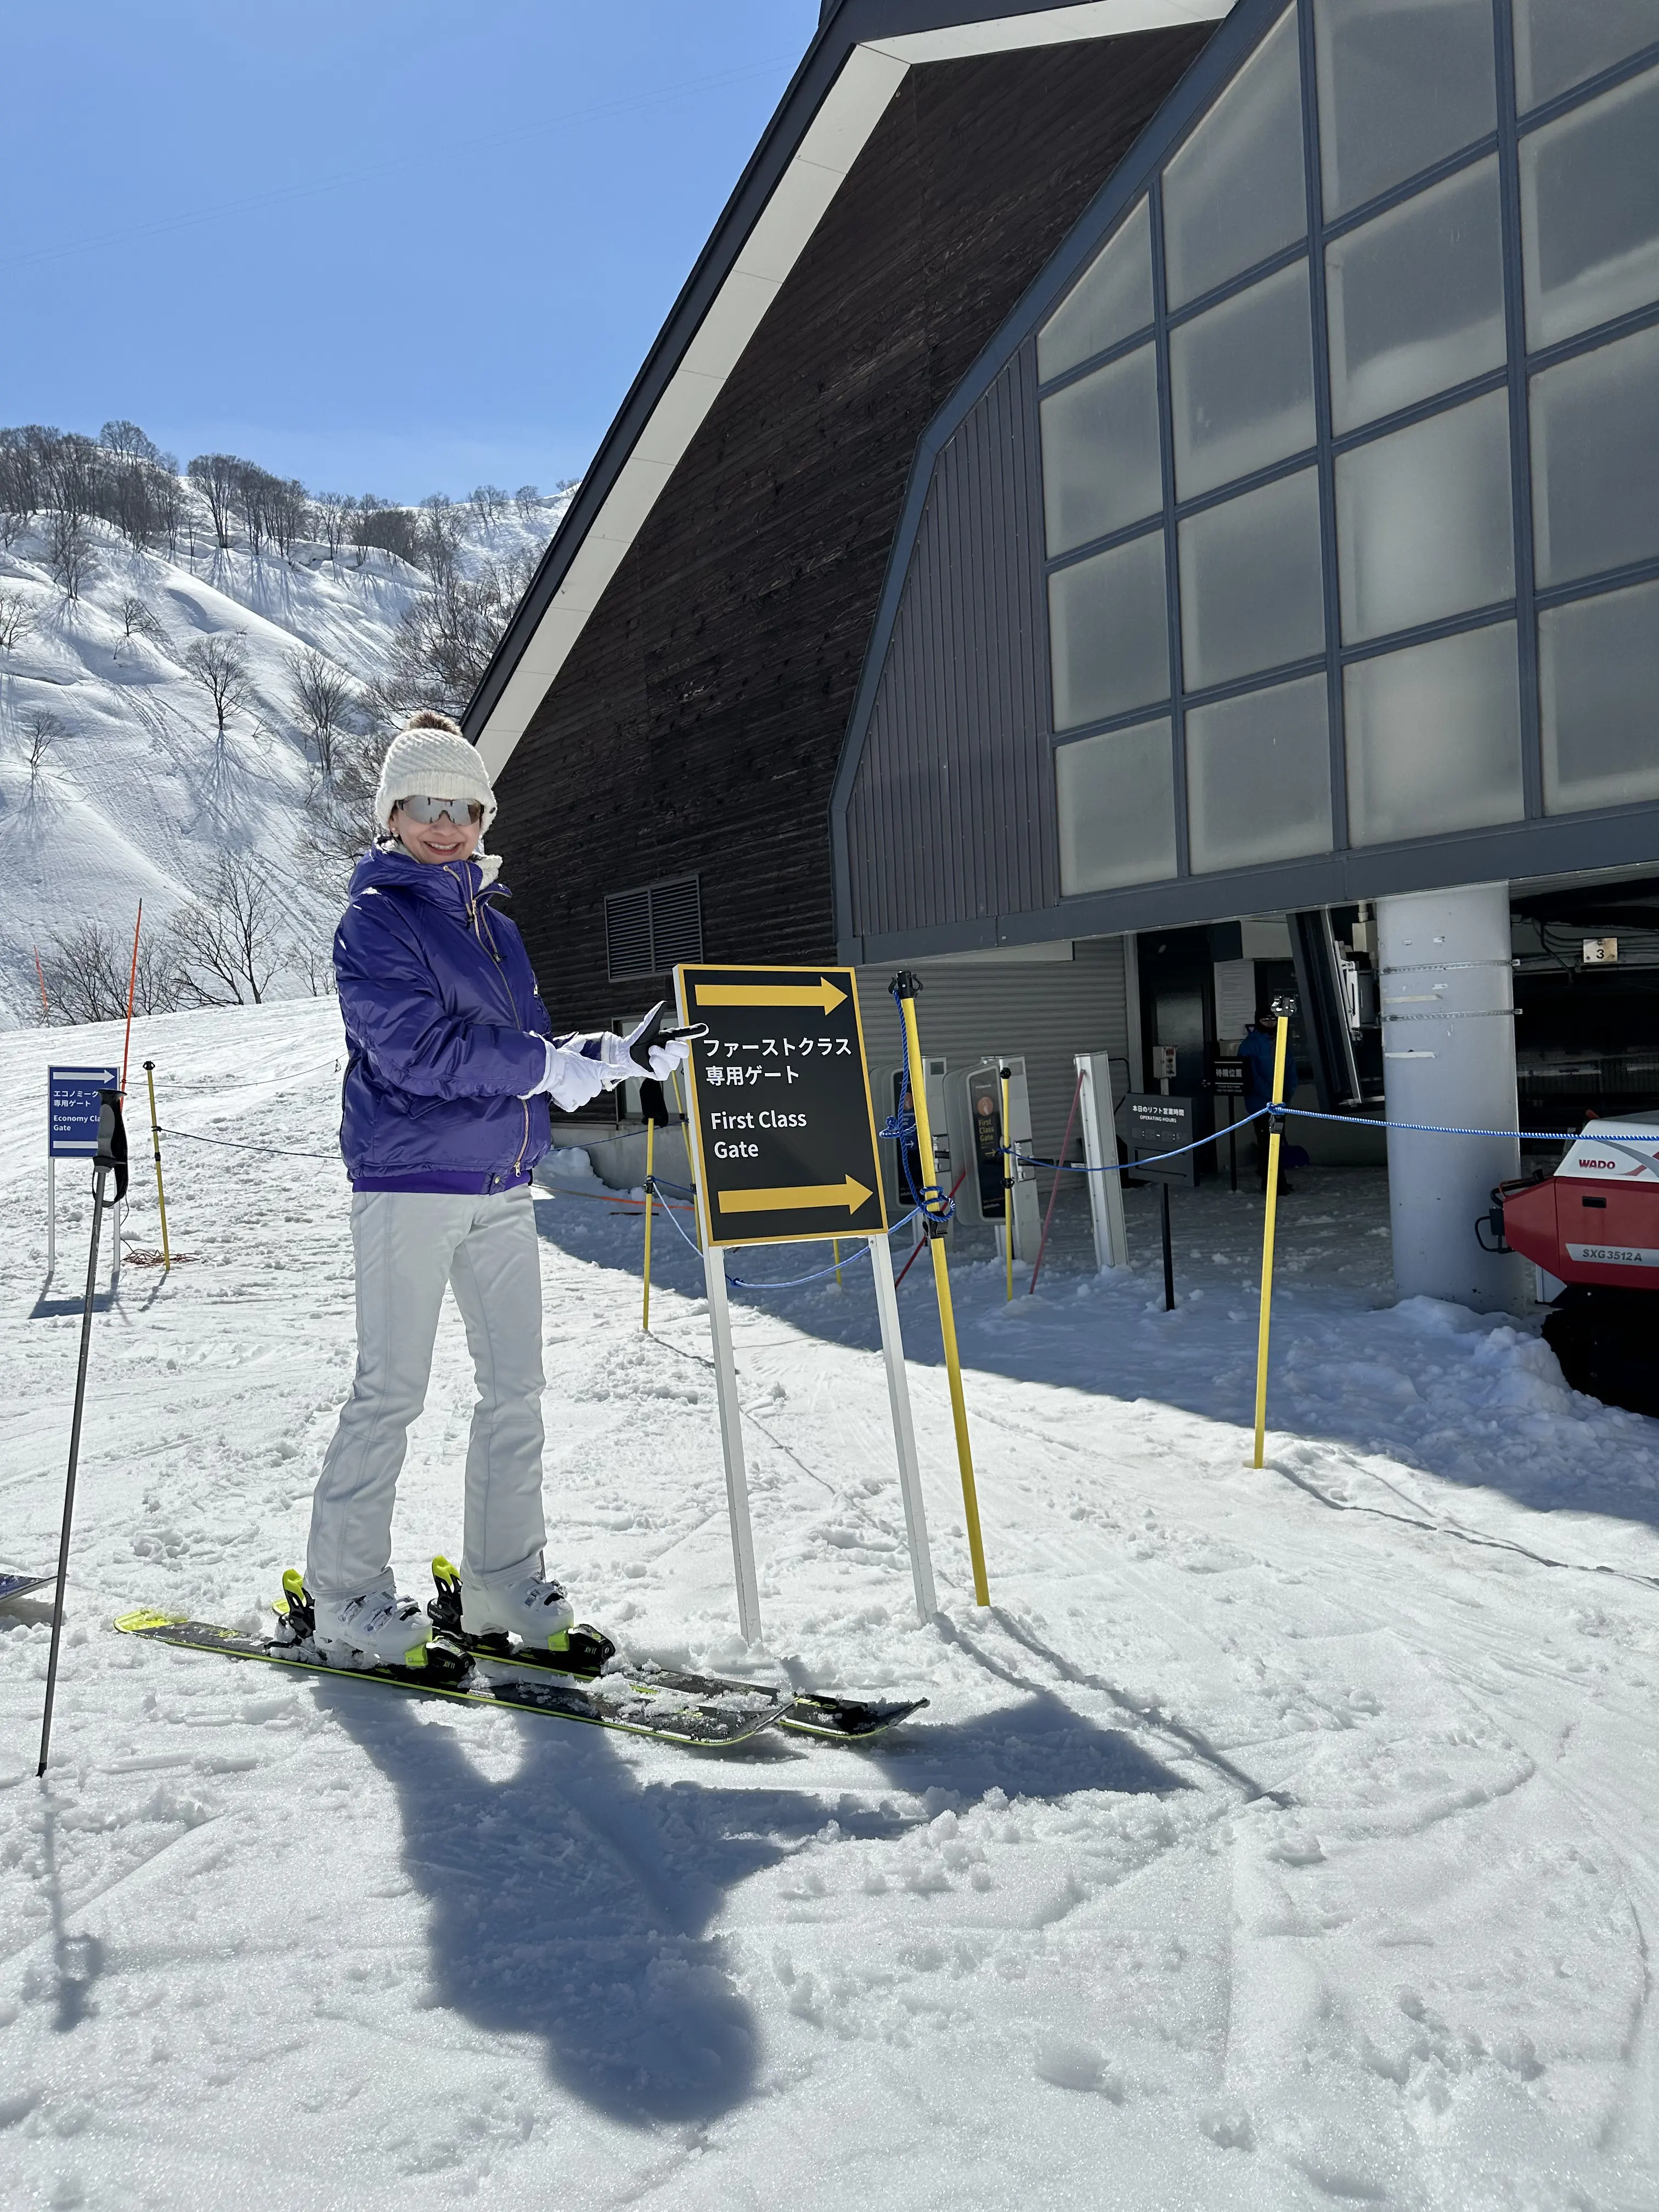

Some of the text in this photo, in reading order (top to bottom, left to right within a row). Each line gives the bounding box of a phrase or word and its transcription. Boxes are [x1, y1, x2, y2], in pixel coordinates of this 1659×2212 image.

[1596, 949, 1605, 959] 3
[703, 1036, 852, 1058] ファーストクラス
[705, 1065, 799, 1086] 専用ゲート
[53, 1099, 91, 1107] 専用ゲート
[1132, 1105, 1184, 1117] 本日のリフト営業時間
[53, 1115, 88, 1124] Economy
[711, 1110, 807, 1130] First Class
[714, 1141, 759, 1159] Gate
[1579, 1159, 1616, 1170] WADO
